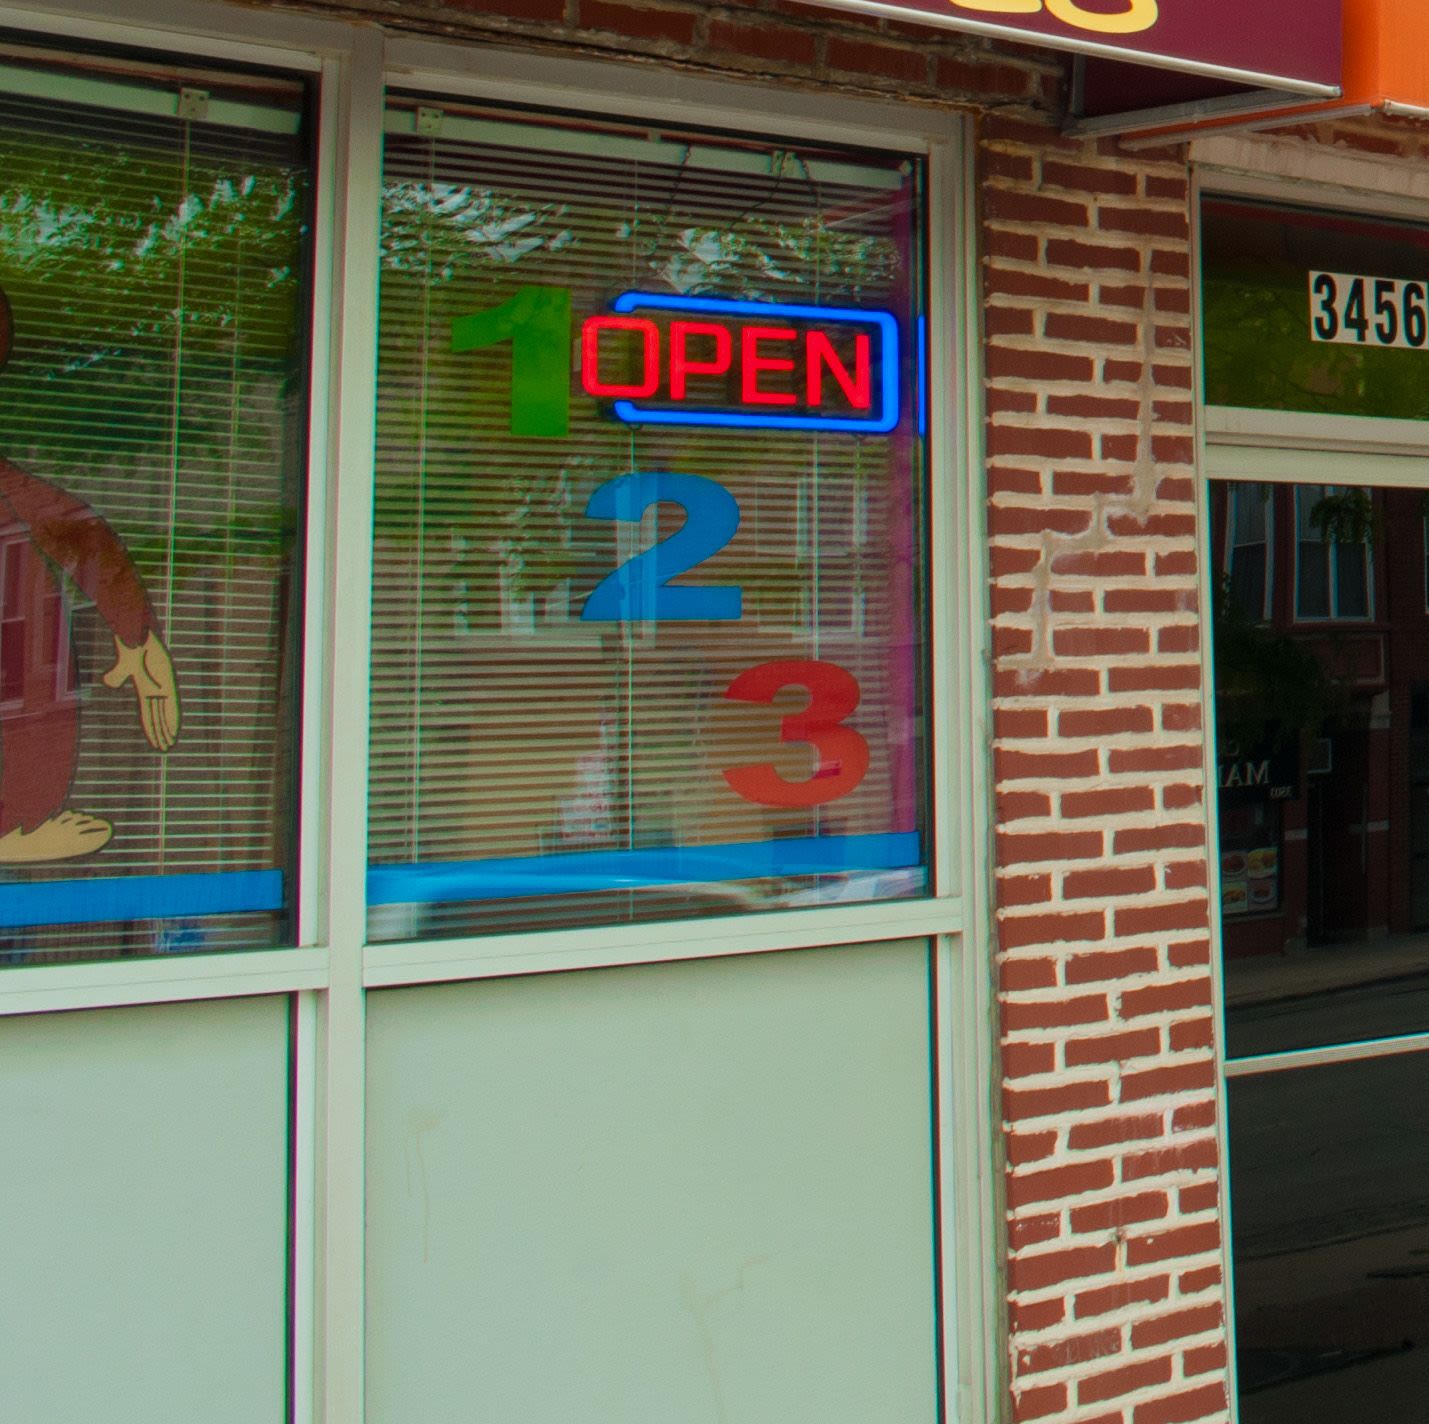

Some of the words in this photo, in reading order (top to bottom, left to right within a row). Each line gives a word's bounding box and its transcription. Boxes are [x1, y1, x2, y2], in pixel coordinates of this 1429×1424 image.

[451, 287, 571, 437] 1
[579, 315, 872, 410] OPEN
[1312, 274, 1429, 349] 3456
[579, 472, 743, 622] 2
[721, 660, 871, 809] 3
